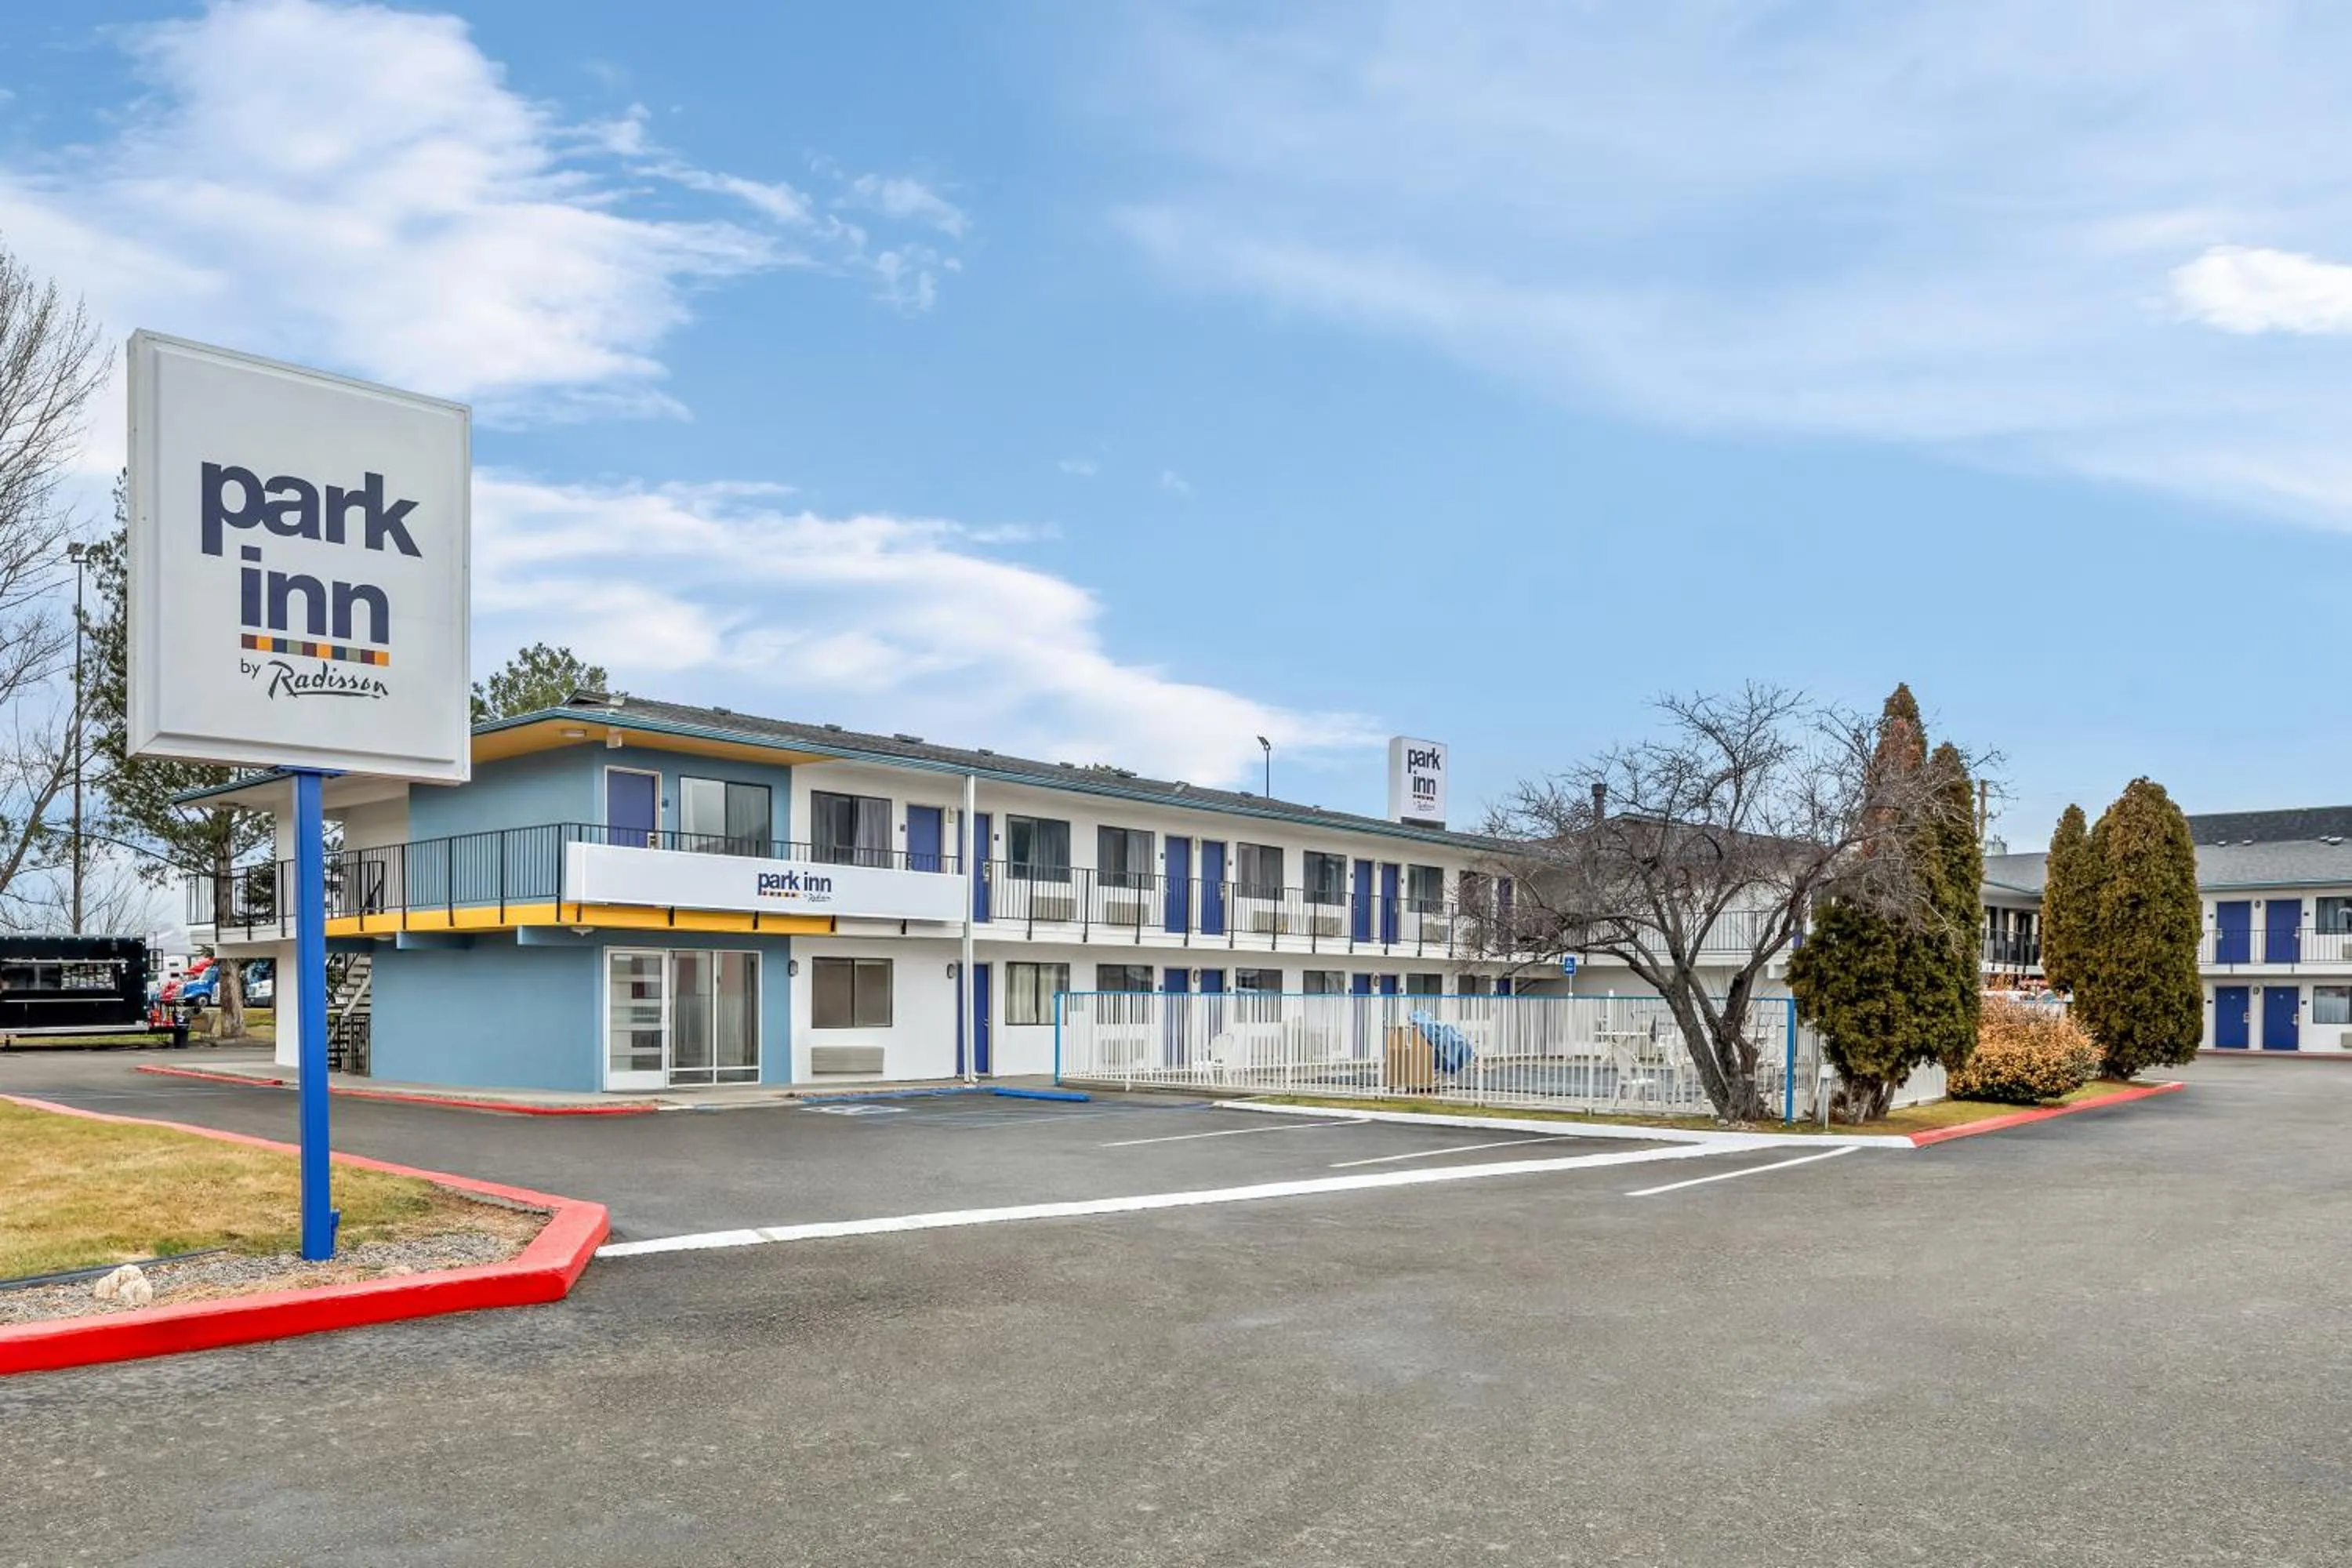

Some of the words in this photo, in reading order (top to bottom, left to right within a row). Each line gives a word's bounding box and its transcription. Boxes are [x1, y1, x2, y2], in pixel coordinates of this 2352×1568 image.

[201, 460, 422, 557] park
[241, 545, 389, 644] inn
[241, 659, 261, 679] by
[267, 659, 388, 700] Radisson
[1407, 747, 1441, 773] park
[1413, 770, 1436, 795] inn
[757, 869, 800, 895] park
[804, 871, 832, 892] inn
